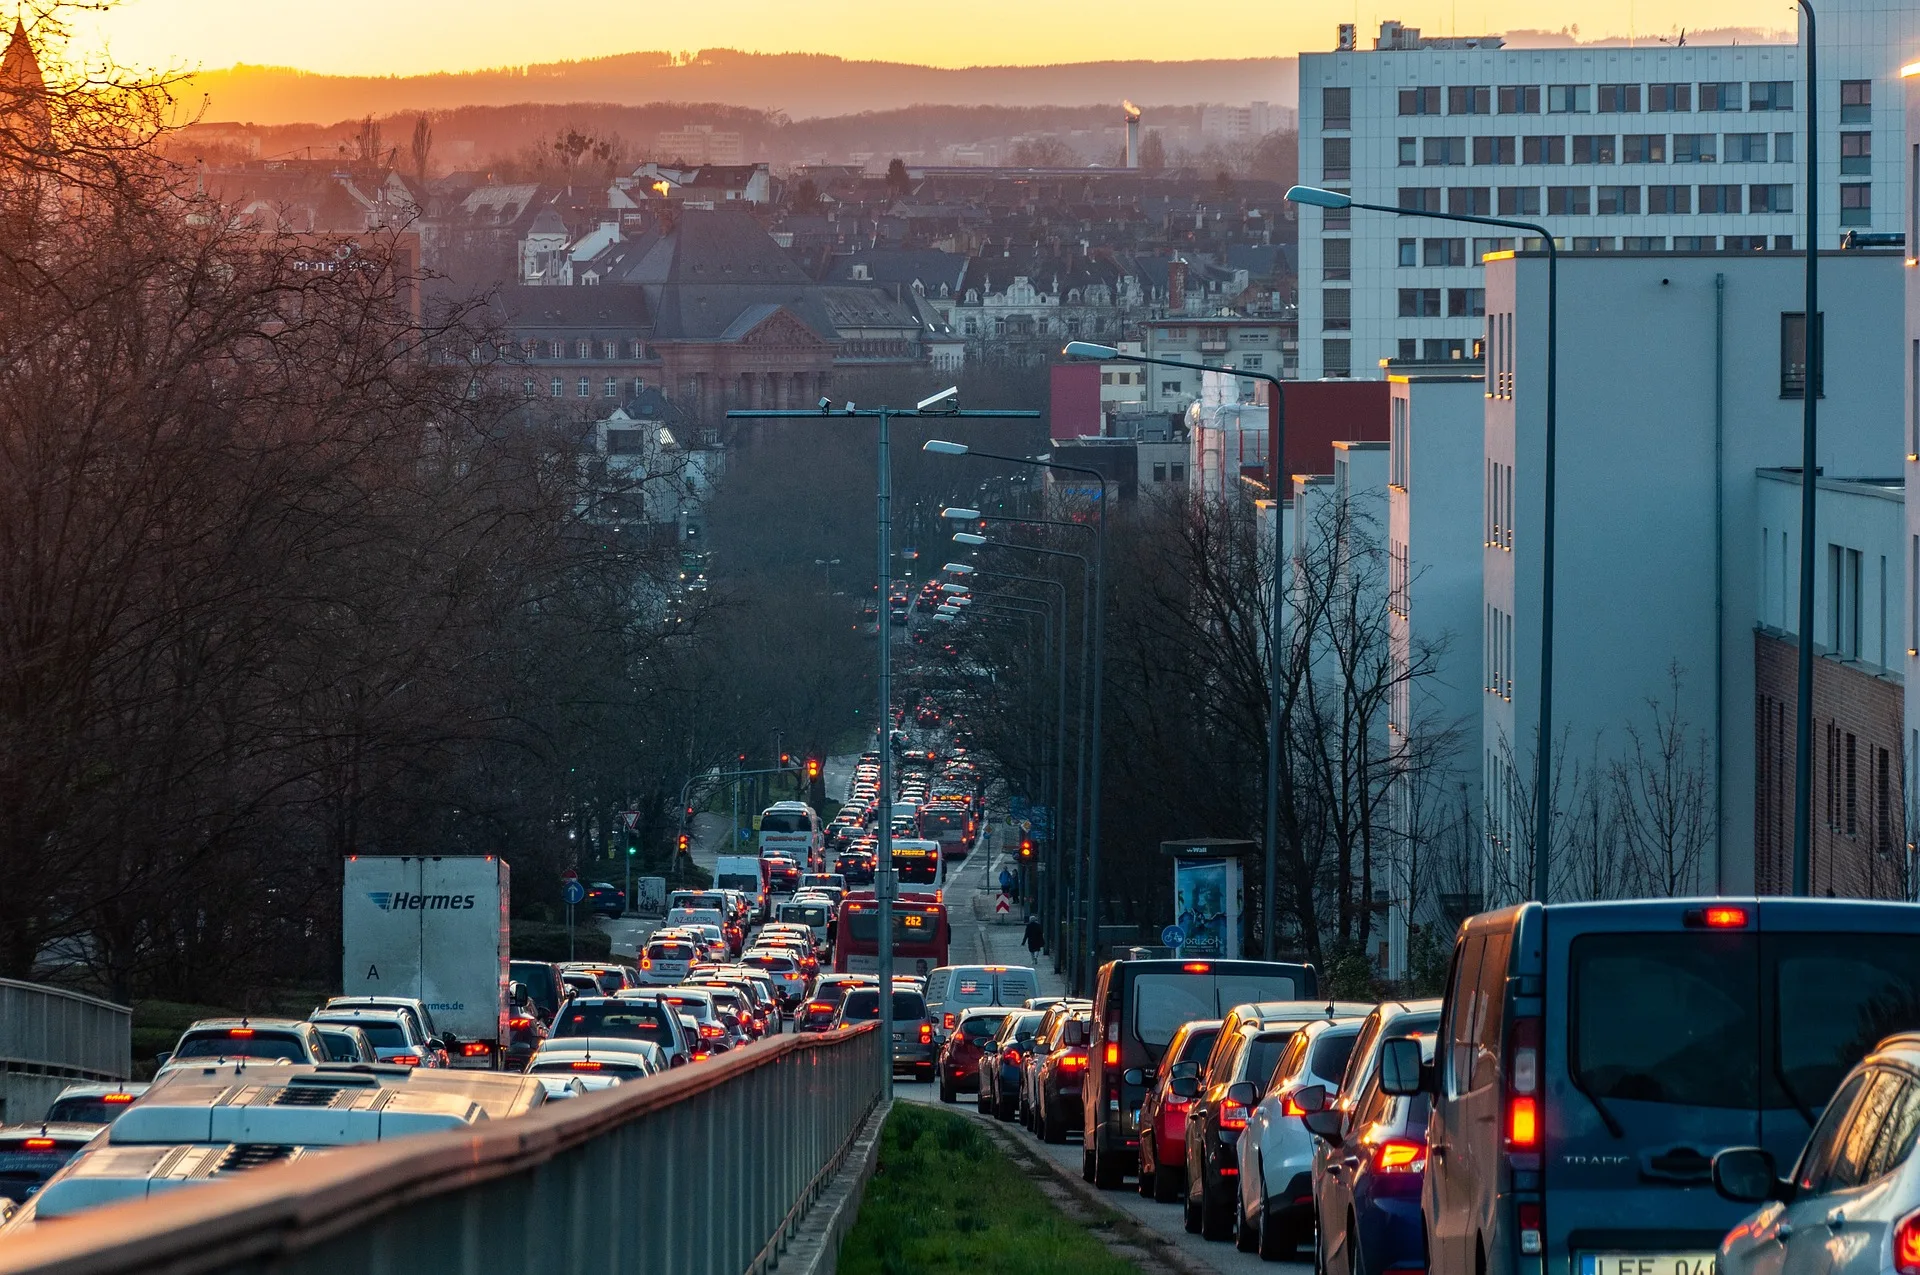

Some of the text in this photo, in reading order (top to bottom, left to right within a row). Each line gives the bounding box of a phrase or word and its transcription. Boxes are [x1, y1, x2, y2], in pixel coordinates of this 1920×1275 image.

[393, 892, 475, 910] Hermes
[905, 916, 922, 926] 262
[366, 965, 380, 980] A
[1562, 1155, 1630, 1165] TRAFIC
